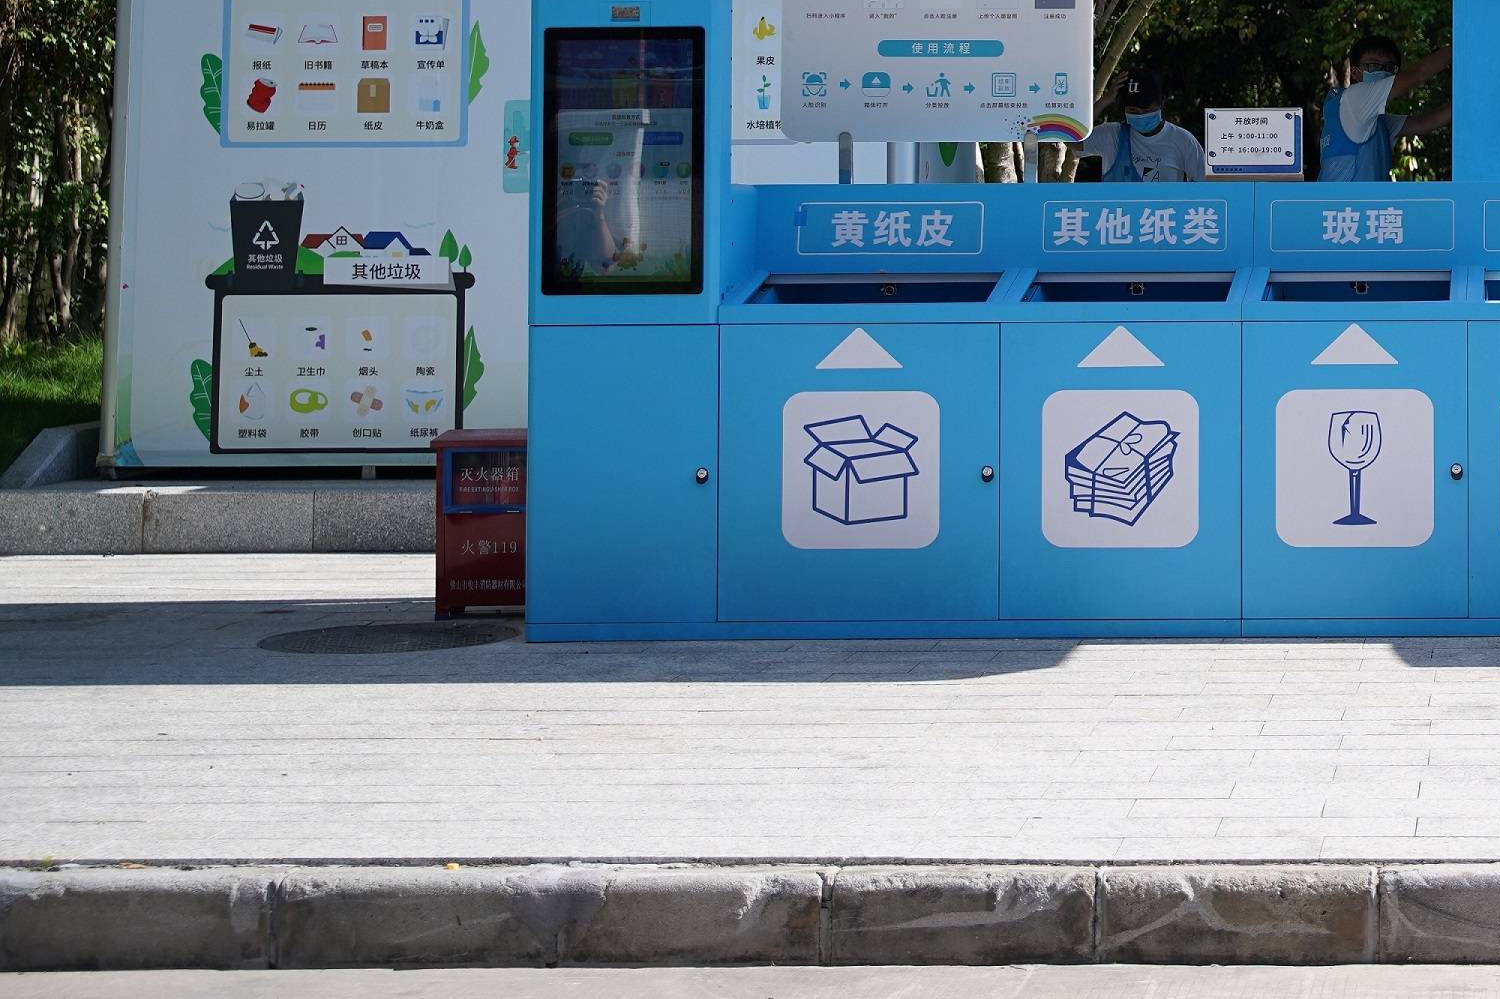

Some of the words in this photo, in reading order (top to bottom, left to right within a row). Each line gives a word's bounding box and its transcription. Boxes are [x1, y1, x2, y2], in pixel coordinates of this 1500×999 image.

[911, 42, 971, 55] 使用流程
[253, 60, 272, 70] 报纸
[304, 60, 333, 70] 旧书籍
[360, 60, 389, 70] 草稿本
[417, 60, 445, 70] 宣传单
[757, 56, 775, 66] 果皮
[246, 120, 275, 131] 易拉罐
[308, 120, 327, 131] 日历
[364, 120, 383, 131] 纸皮
[416, 120, 444, 131] 牛奶盒
[1235, 116, 1269, 126] 开放时间
[1221, 132, 1234, 140] 上午
[1238, 132, 1278, 140] 9:00-11:00
[830, 209, 954, 248] 黄纸皮
[1052, 206, 1220, 246] 其他纸类
[1322, 207, 1404, 245] 玻璃
[248, 253, 283, 264] 其他垃圾
[352, 263, 421, 280] 其他垃圾
[244, 366, 264, 377] 尘土
[297, 366, 326, 377] 卫生巾
[358, 366, 378, 377] 烟头
[415, 366, 435, 377] 陶瓷
[238, 428, 267, 439] 塑料袋
[300, 428, 320, 439] 胶带
[352, 428, 382, 439] 创口贴
[410, 428, 438, 439] 纸尿裤
[460, 466, 520, 482] 灭火器箱
[462, 539, 518, 555] 火警119
